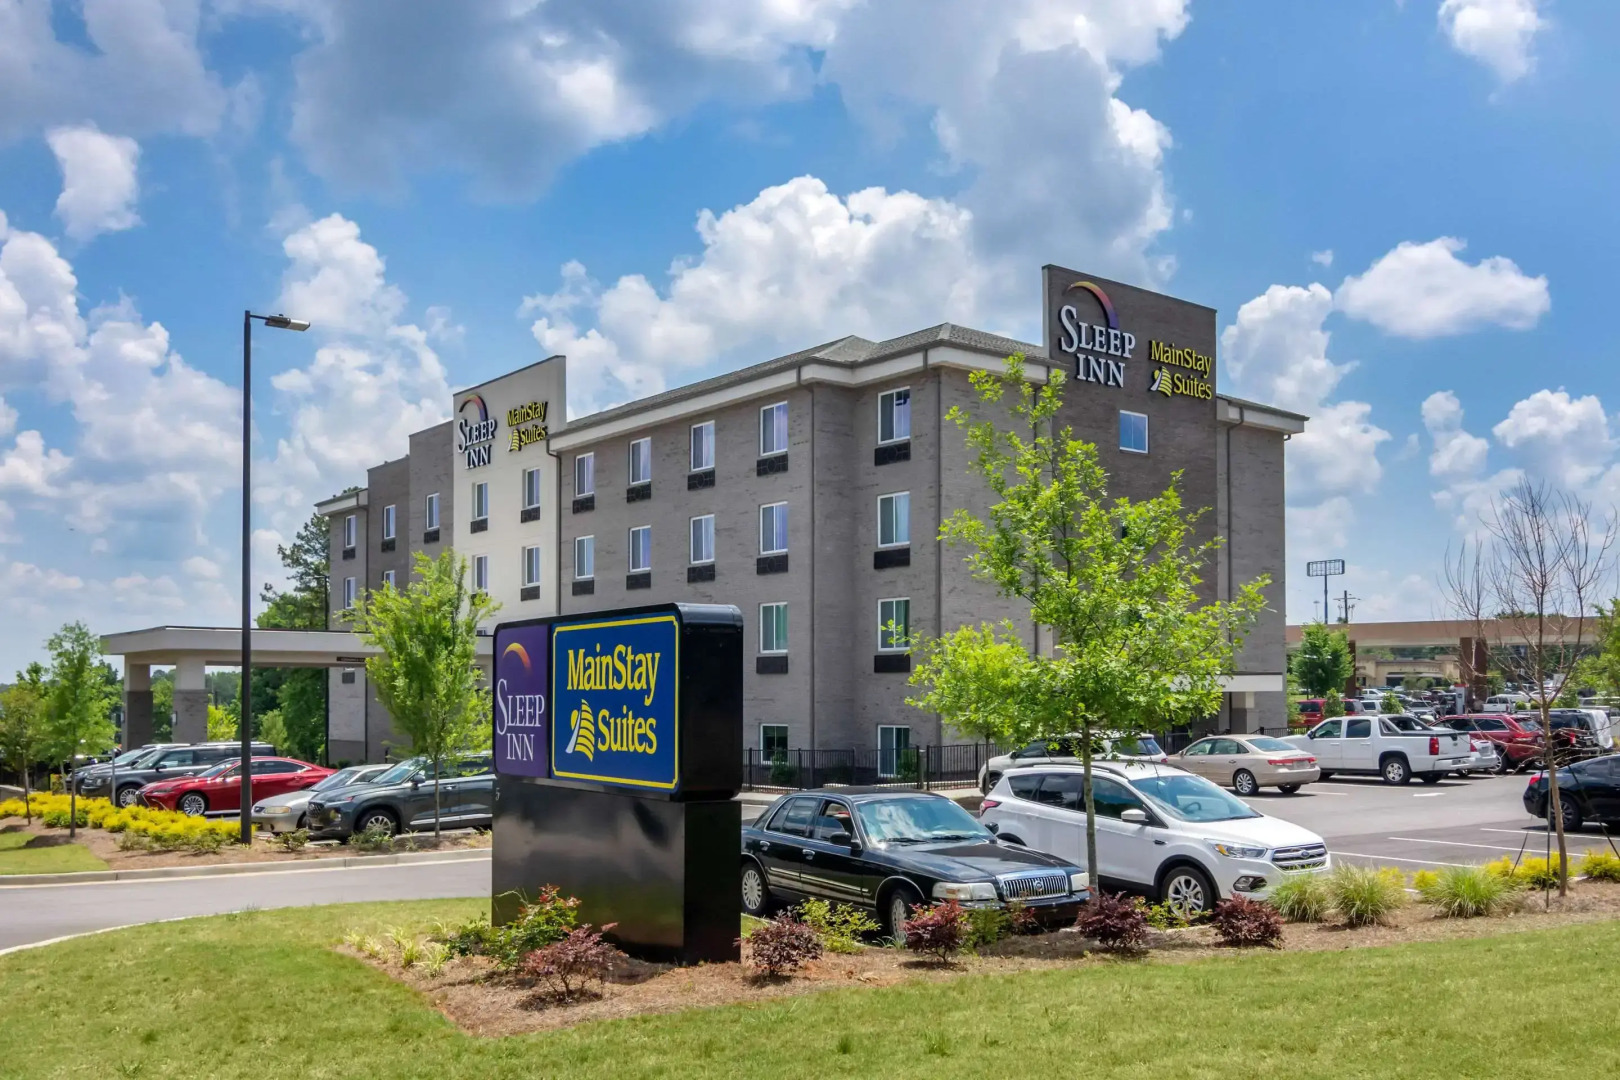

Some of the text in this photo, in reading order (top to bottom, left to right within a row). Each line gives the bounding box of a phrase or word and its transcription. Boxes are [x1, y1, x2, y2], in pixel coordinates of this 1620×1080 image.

[1060, 304, 1136, 359] SLEEP
[1076, 353, 1126, 388] INN
[1150, 340, 1212, 379] MainStay
[1173, 373, 1213, 400] Suites
[507, 401, 548, 427] MainStay
[458, 418, 497, 453] SLEEP
[520, 425, 547, 446] Suites
[464, 444, 491, 470] INN
[567, 643, 660, 707] MainStay
[497, 678, 545, 735] SLEEP
[506, 733, 535, 762] INN
[597, 705, 657, 755] Suites
